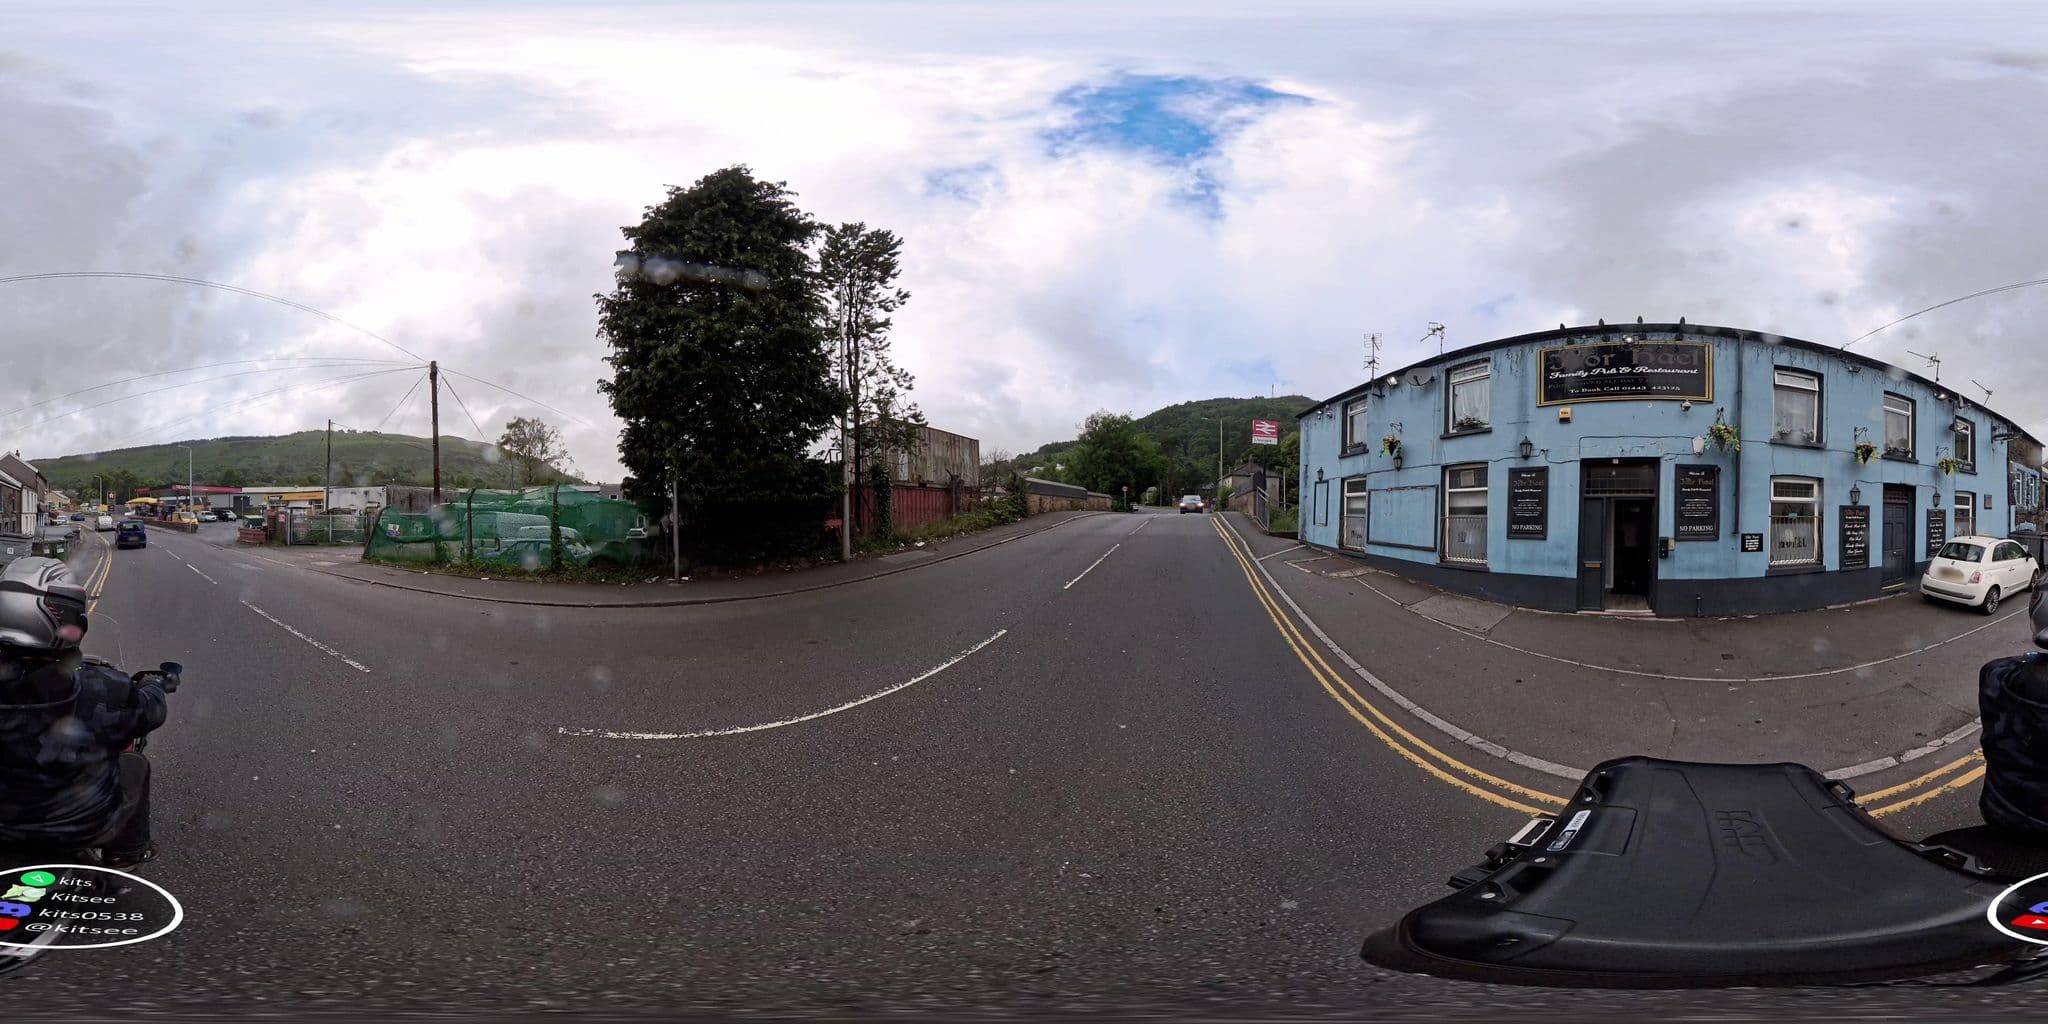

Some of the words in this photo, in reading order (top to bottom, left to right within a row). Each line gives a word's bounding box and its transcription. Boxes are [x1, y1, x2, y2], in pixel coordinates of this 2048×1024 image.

[1549, 370, 1588, 379] Family
[1590, 367, 1619, 376] Pub
[1619, 366, 1632, 374] &
[1632, 366, 1699, 375] Restaurant
